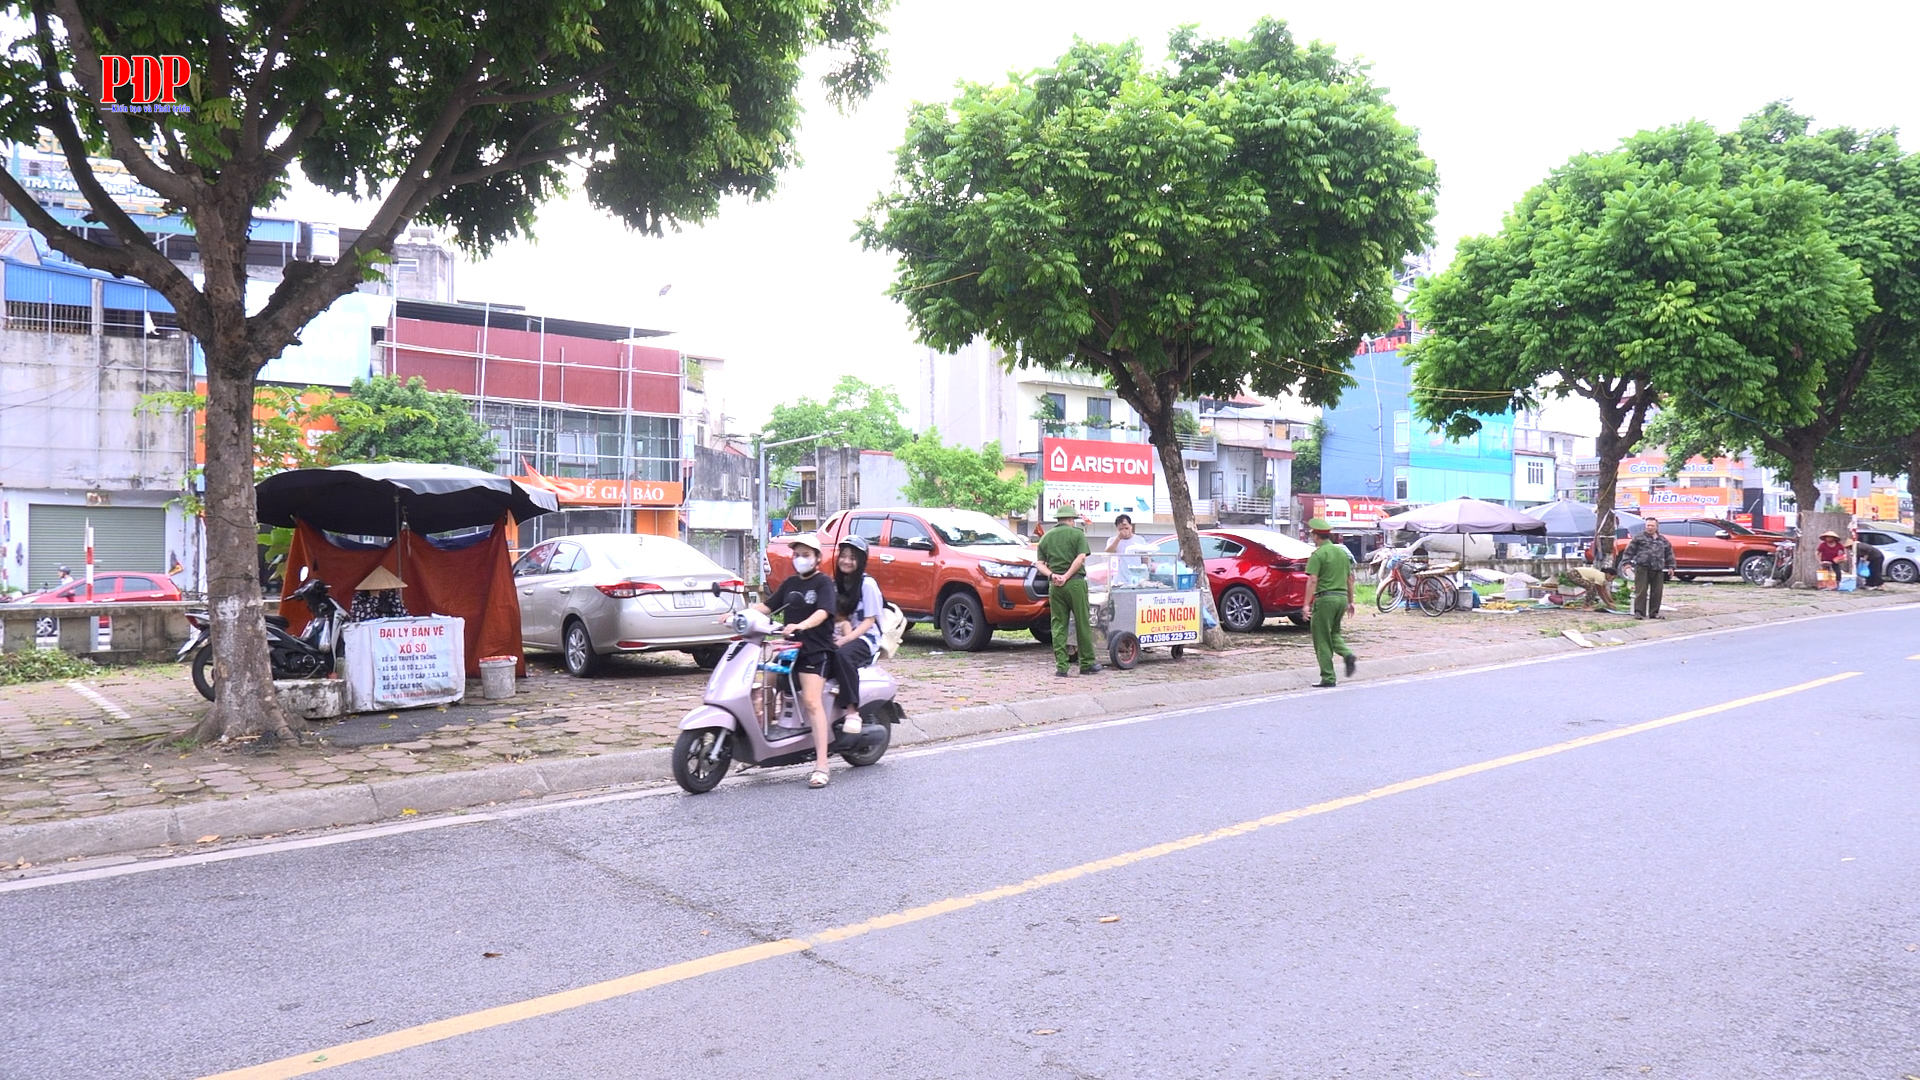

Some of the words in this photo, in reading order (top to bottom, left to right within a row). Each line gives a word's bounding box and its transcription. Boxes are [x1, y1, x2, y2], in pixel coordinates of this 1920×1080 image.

[1071, 455, 1149, 475] ARISTON
[633, 484, 664, 501] BẢO
[1693, 495, 1719, 504] Ngay
[1141, 606, 1166, 623] LÒNG
[1169, 607, 1196, 622] NGON
[379, 628, 395, 640] ĐẠI
[399, 625, 408, 637] LÝ
[1170, 632, 1183, 641] 229
